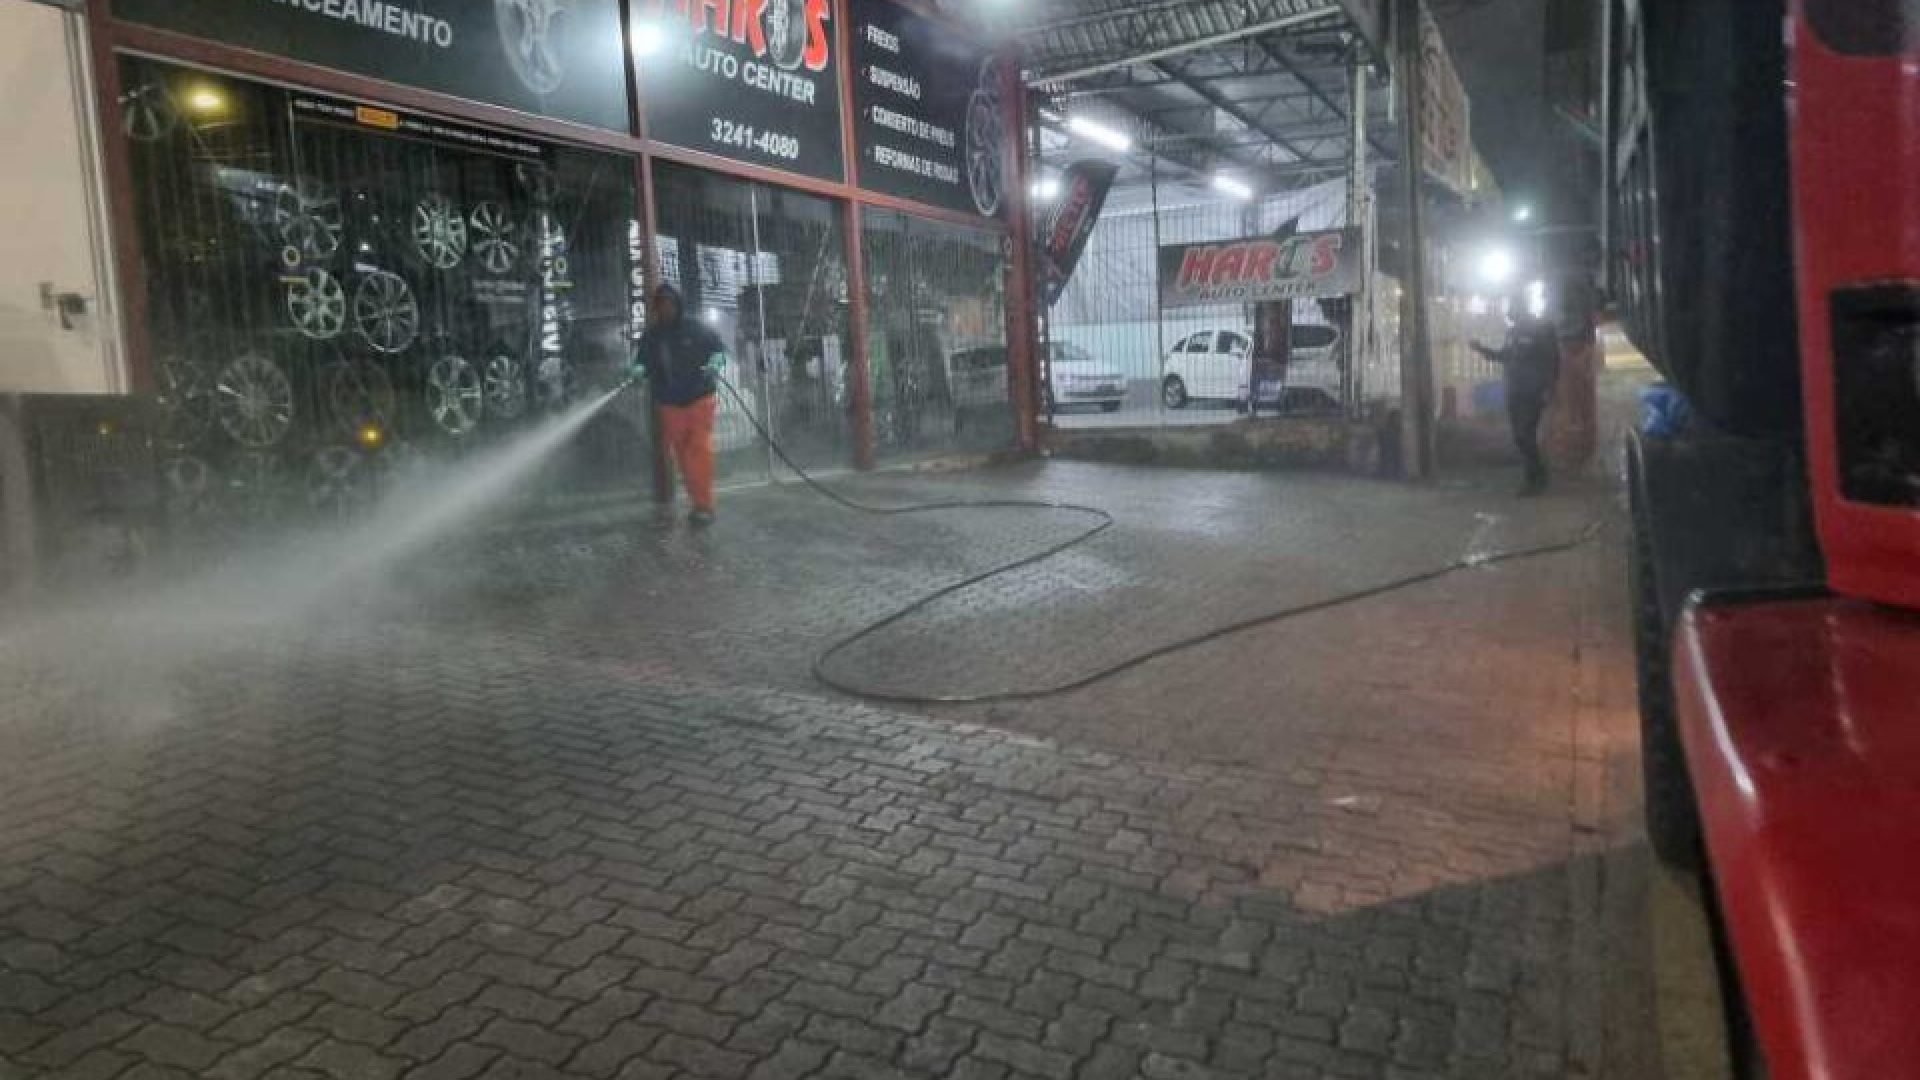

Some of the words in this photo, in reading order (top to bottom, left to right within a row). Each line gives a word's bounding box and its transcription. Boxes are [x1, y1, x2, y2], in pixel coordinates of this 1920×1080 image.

[272, 0, 451, 47] CEAMENTO
[743, 62, 815, 104] CENTER
[711, 117, 799, 159] 3241-4080
